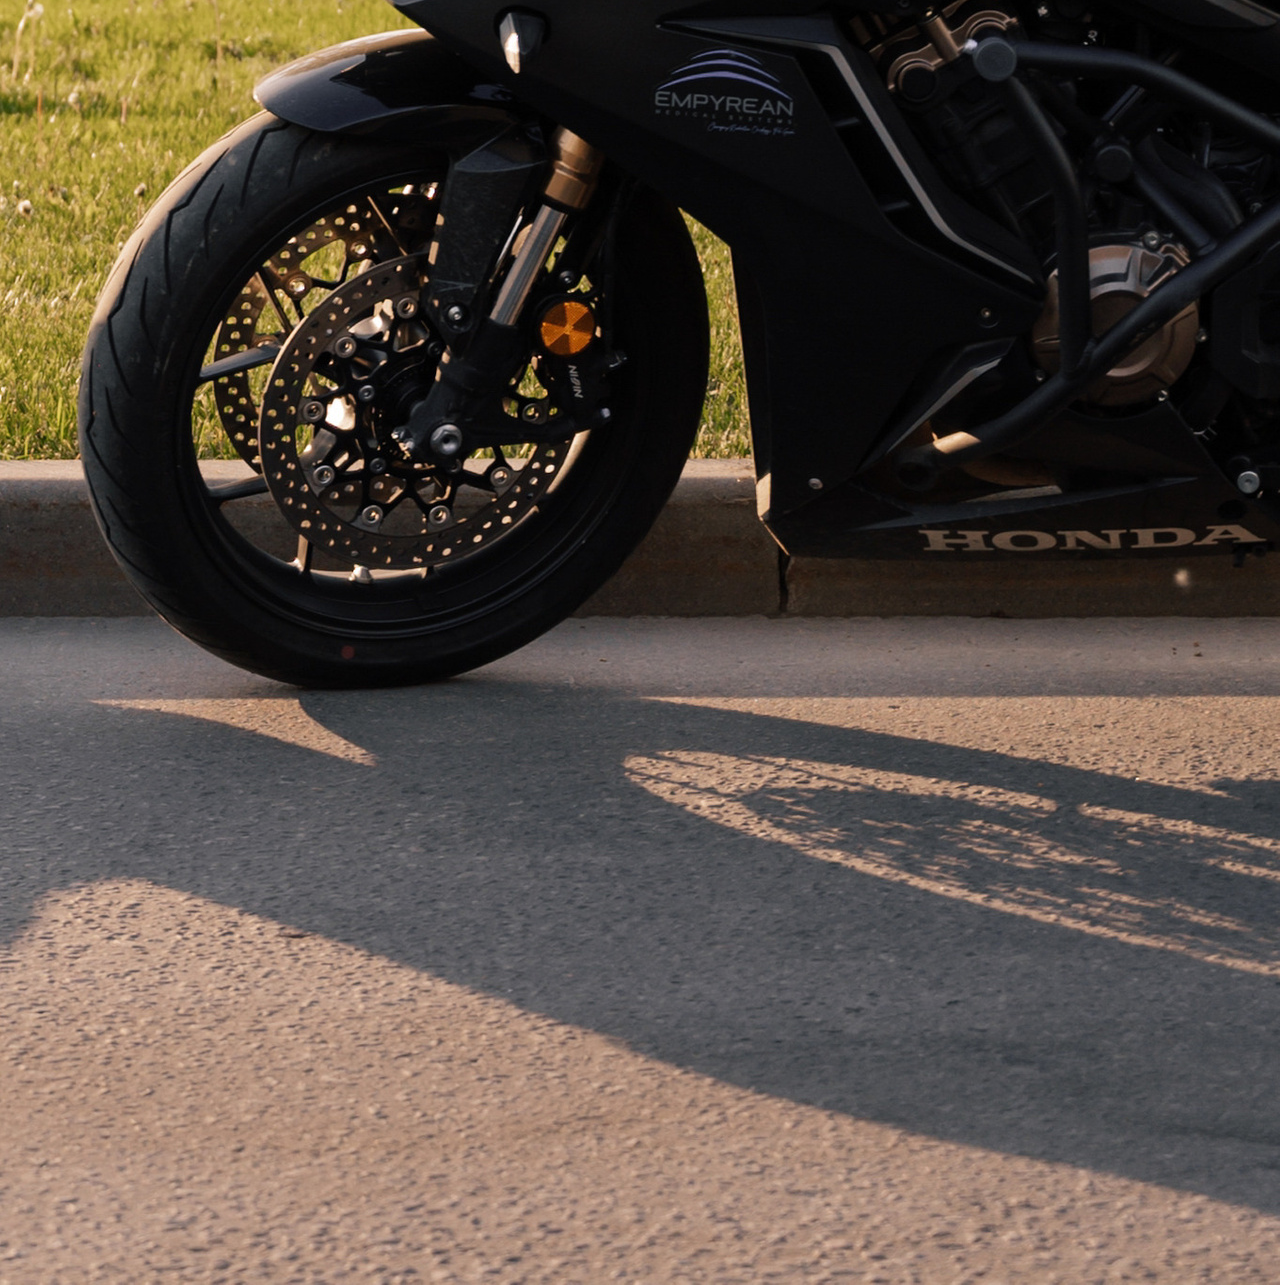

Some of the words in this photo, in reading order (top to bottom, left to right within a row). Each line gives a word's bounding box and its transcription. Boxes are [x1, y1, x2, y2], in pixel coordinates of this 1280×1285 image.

[654, 91, 794, 117] EMPYREAN
[655, 109, 716, 120] MEDICAL
[728, 115, 793, 125] SYSTEMS
[918, 524, 1268, 552] HONDA
